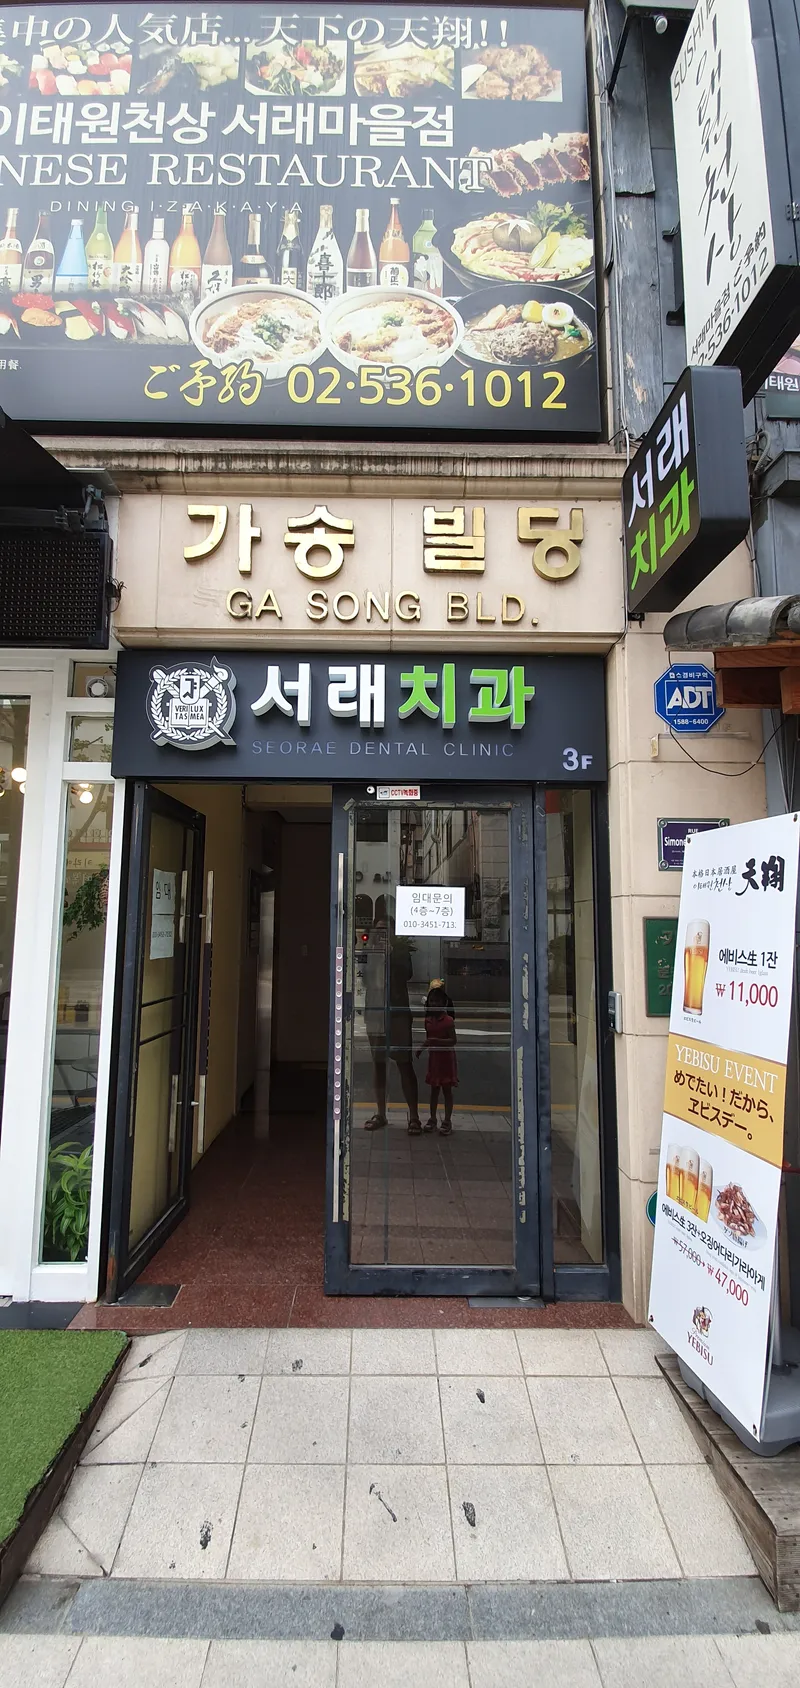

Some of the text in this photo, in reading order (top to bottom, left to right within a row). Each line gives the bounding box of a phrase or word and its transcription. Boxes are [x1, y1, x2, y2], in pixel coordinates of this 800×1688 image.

[673, 6, 705, 102] SUSHI
[222, 102, 454, 147] 서래마을점
[147, 153, 492, 192] RESTAURANT
[50, 200, 134, 212] DINING
[144, 359, 262, 406] ご予約
[628, 391, 690, 528] 서래
[184, 504, 585, 582] 가송 빌딩
[630, 466, 695, 590] 치과
[225, 588, 539, 626] GA SONG BLD.
[190, 705, 204, 713] LUX
[250, 662, 535, 730] 서래치과
[667, 685, 713, 709] ADT
[174, 712, 205, 720] TAS MEA
[252, 740, 514, 757] SEORAE DENTAL CLINIC
[562, 747, 593, 771] 3F
[410, 906, 454, 917] (4층~7층)
[411, 892, 453, 904] 임대문의
[760, 951, 778, 969] 1잔
[675, 1044, 778, 1093] YEBISU EVENT
[687, 1331, 714, 1366] YEBISU
